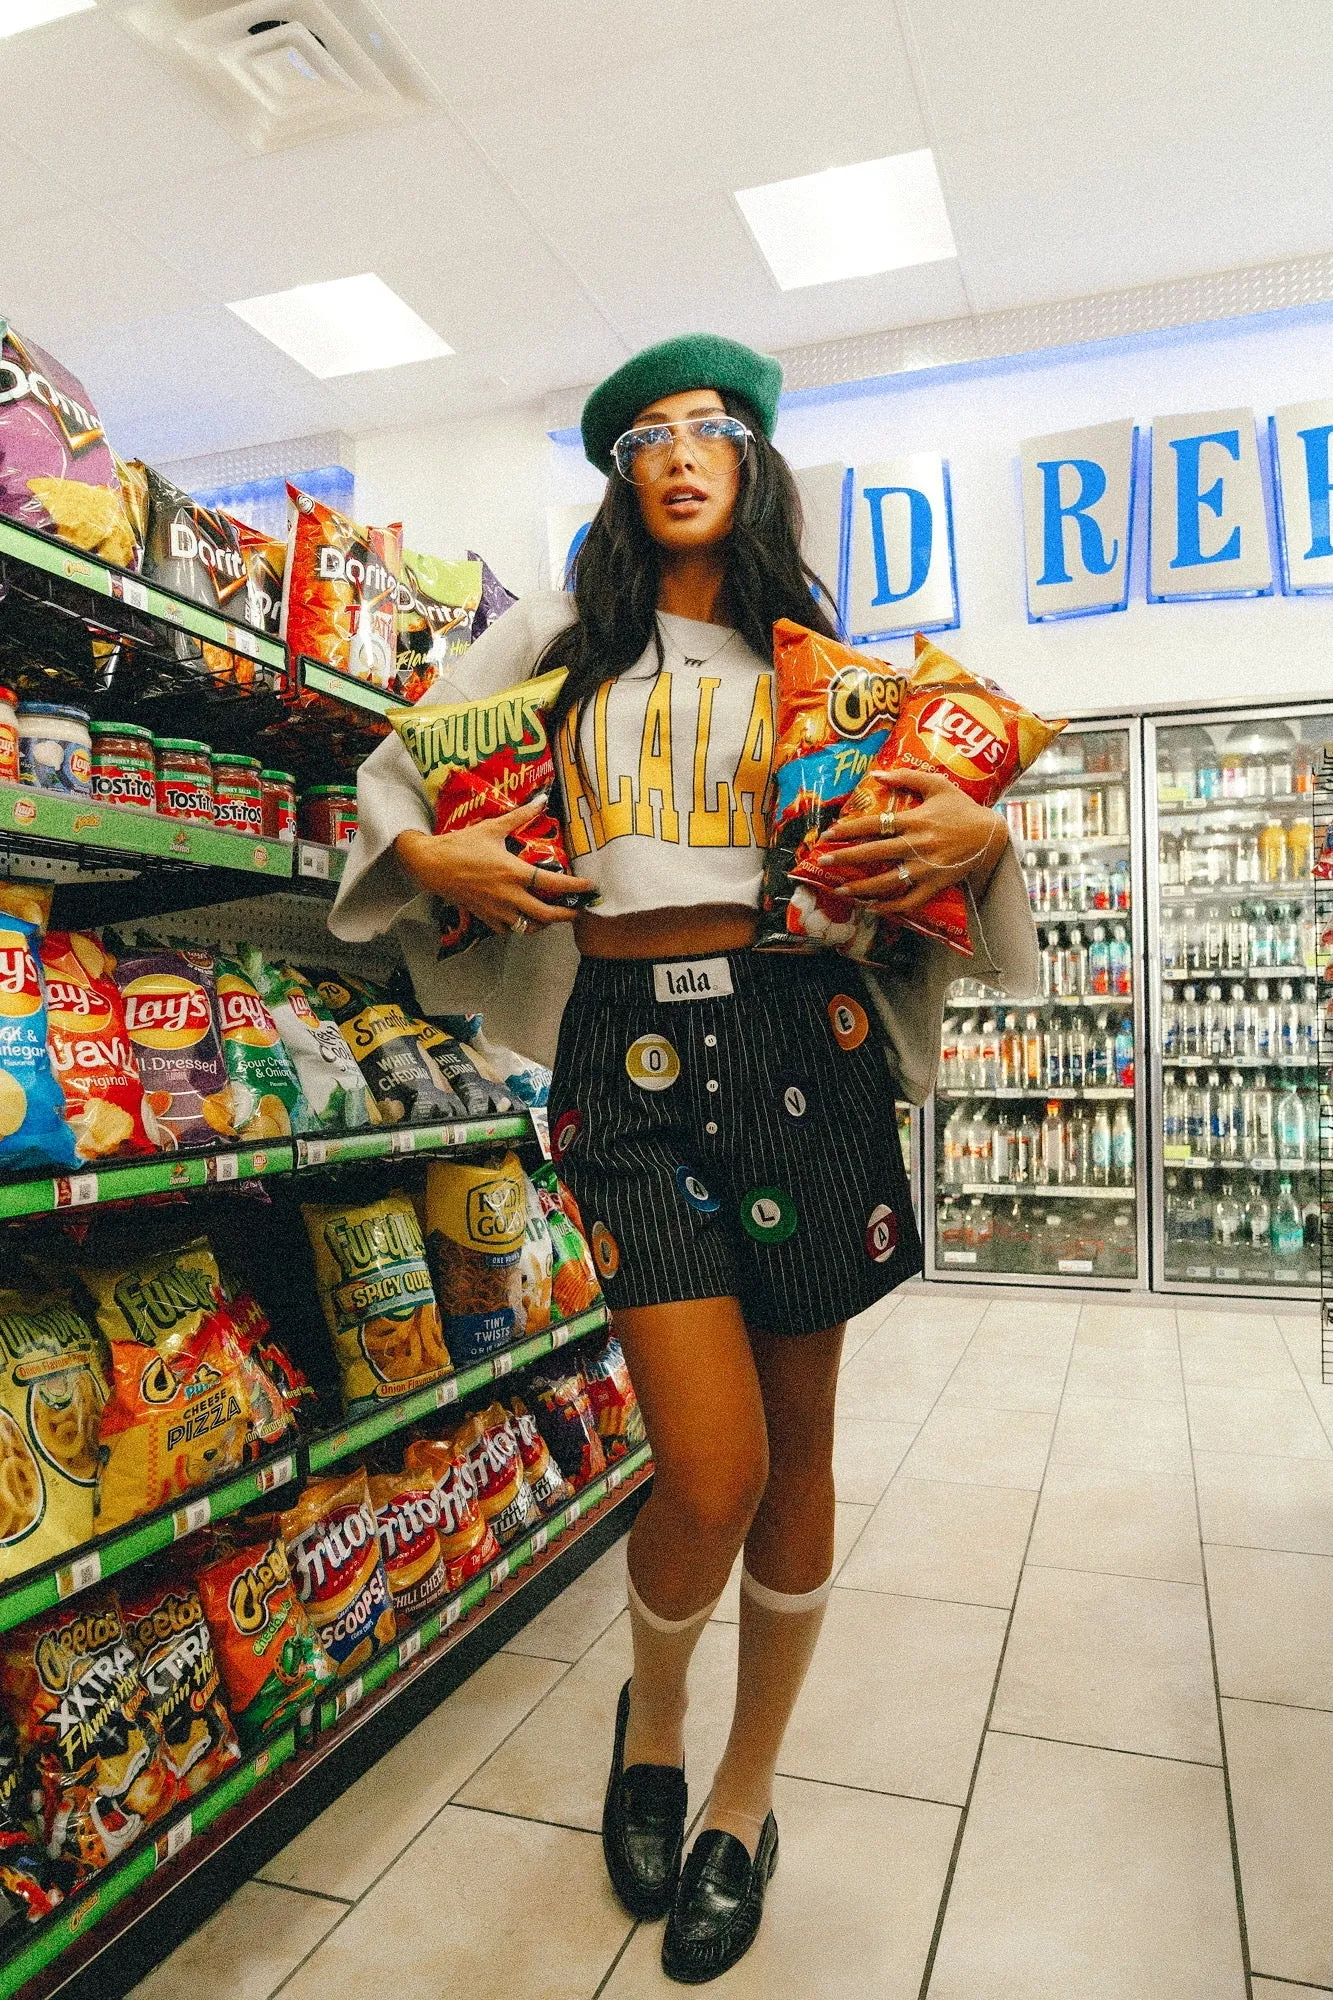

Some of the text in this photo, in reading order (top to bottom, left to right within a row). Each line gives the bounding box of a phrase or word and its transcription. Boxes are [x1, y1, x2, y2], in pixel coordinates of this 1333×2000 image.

[922, 699, 1004, 764] Lay's
[492, 764, 534, 800] Hot
[666, 967, 712, 996] lala
[126, 989, 207, 1032] Lay's
[838, 1009, 853, 1031] E
[376, 1052, 418, 1072] WHITE
[788, 1091, 801, 1113] V
[757, 1202, 775, 1223] L
[876, 1223, 888, 1246] A
[353, 1276, 402, 1309] SPICY
[474, 1326, 511, 1343] TWISTS
[484, 1316, 505, 1330] TINY
[183, 1387, 228, 1420] CHEESE
[381, 1383, 406, 1396] Onion
[167, 1396, 242, 1452] PIZZA
[321, 1568, 385, 1650] SCOOPS!
[43, 1644, 136, 1738] XXTRA
